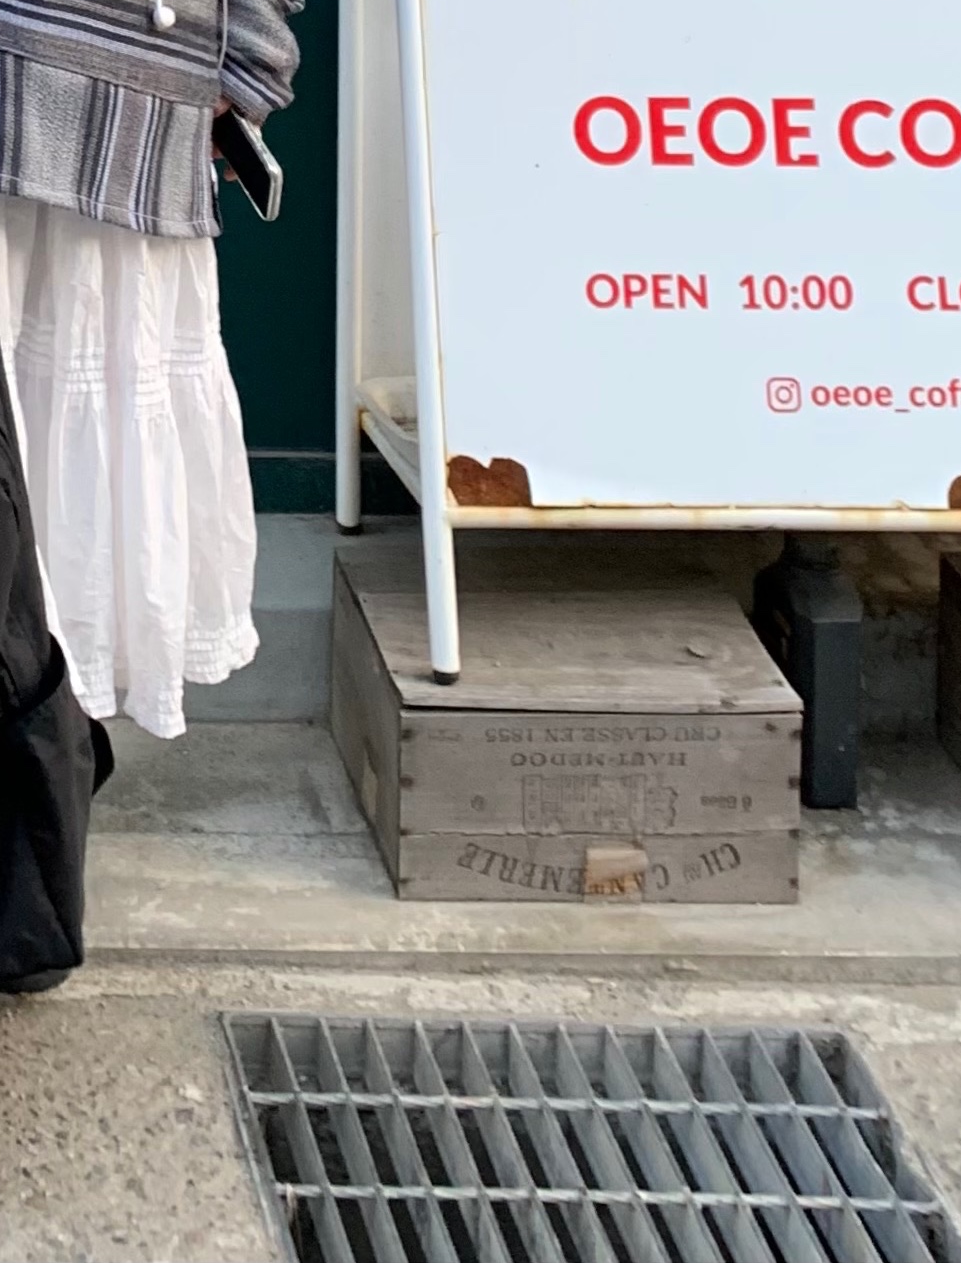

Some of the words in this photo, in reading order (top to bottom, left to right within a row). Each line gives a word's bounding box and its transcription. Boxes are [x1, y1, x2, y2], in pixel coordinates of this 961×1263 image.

[572, 95, 820, 168] OEOE
[585, 273, 709, 309] OPEN
[739, 274, 853, 310] 10:00
[906, 275, 961, 311] CL
[484, 727, 535, 743] 1855
[676, 727, 721, 743] CRU
